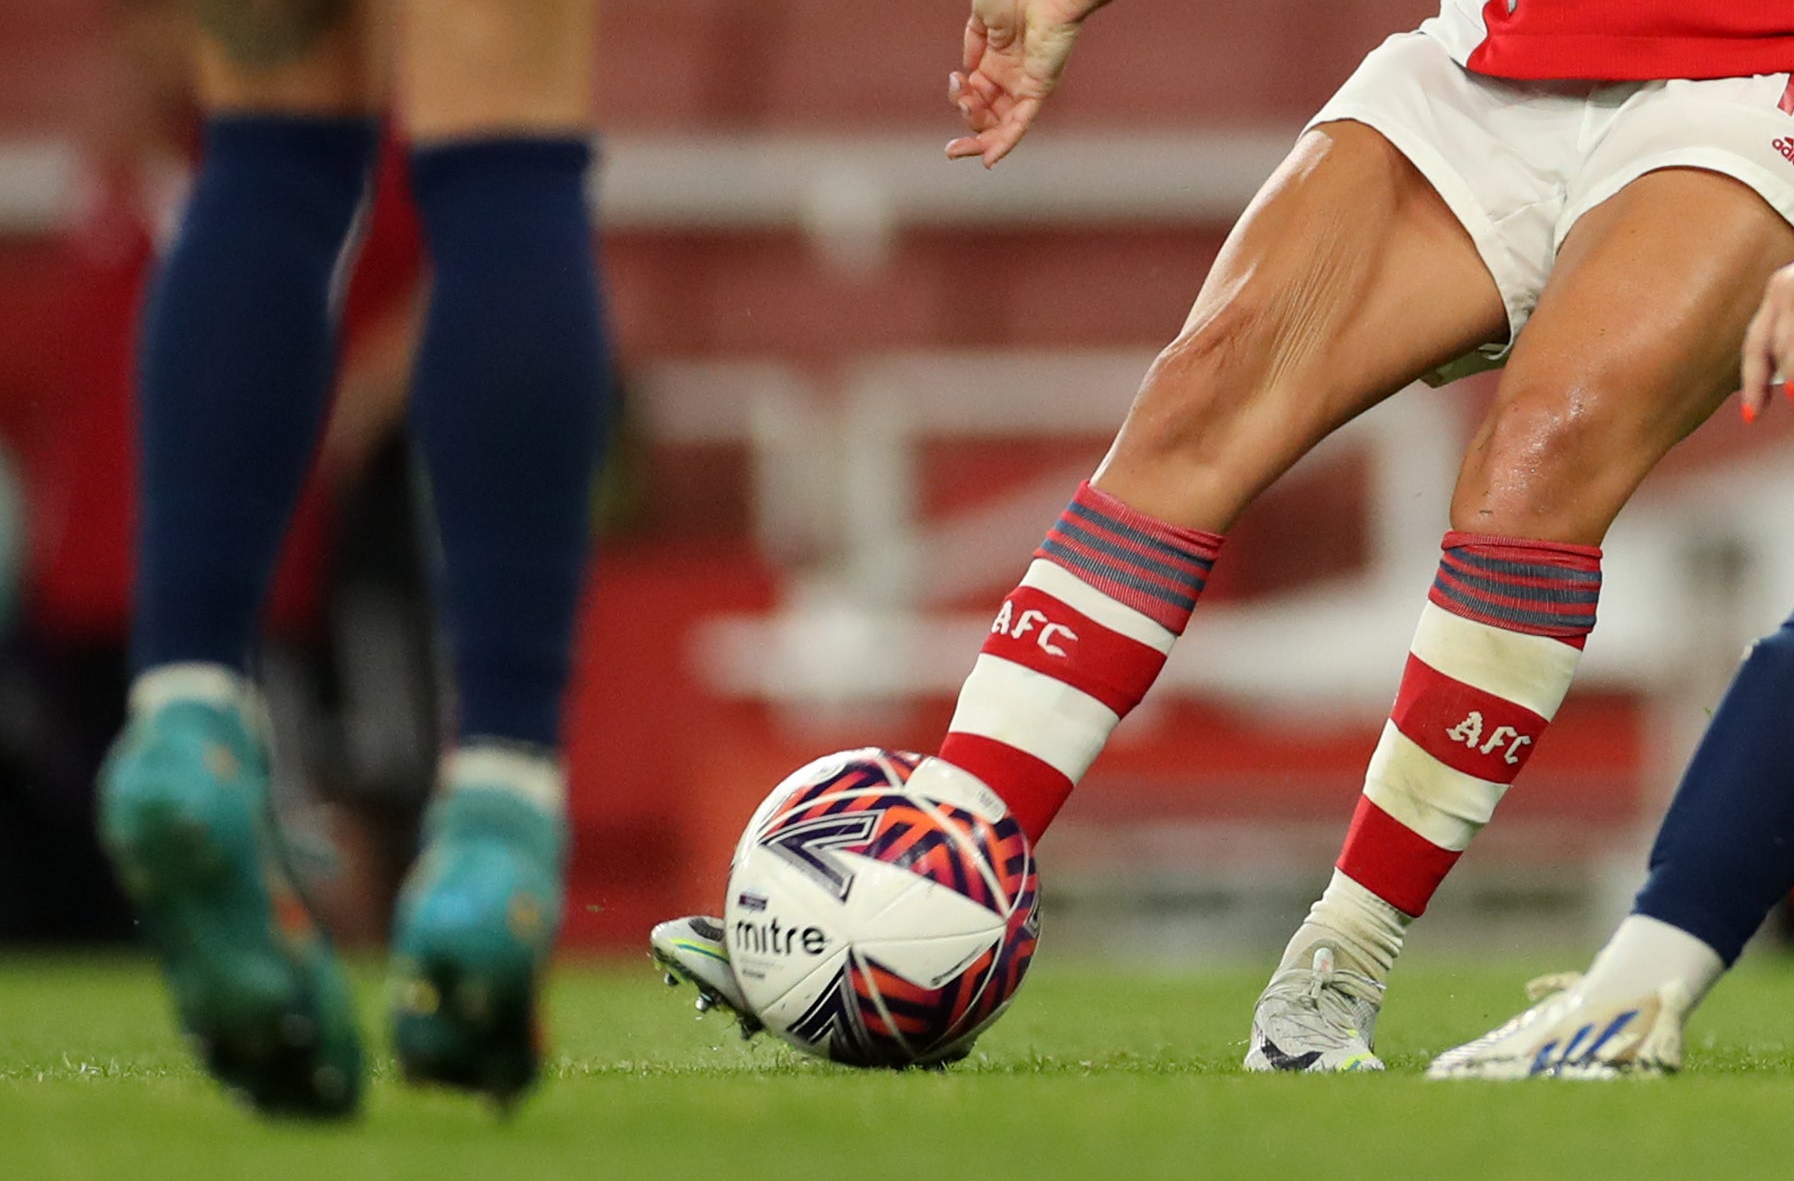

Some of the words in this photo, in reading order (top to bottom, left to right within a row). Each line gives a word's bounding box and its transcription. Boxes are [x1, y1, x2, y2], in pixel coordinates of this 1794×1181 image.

[991, 600, 1079, 657] AFC
[1446, 711, 1531, 764] AFC
[736, 917, 825, 955] mitre
